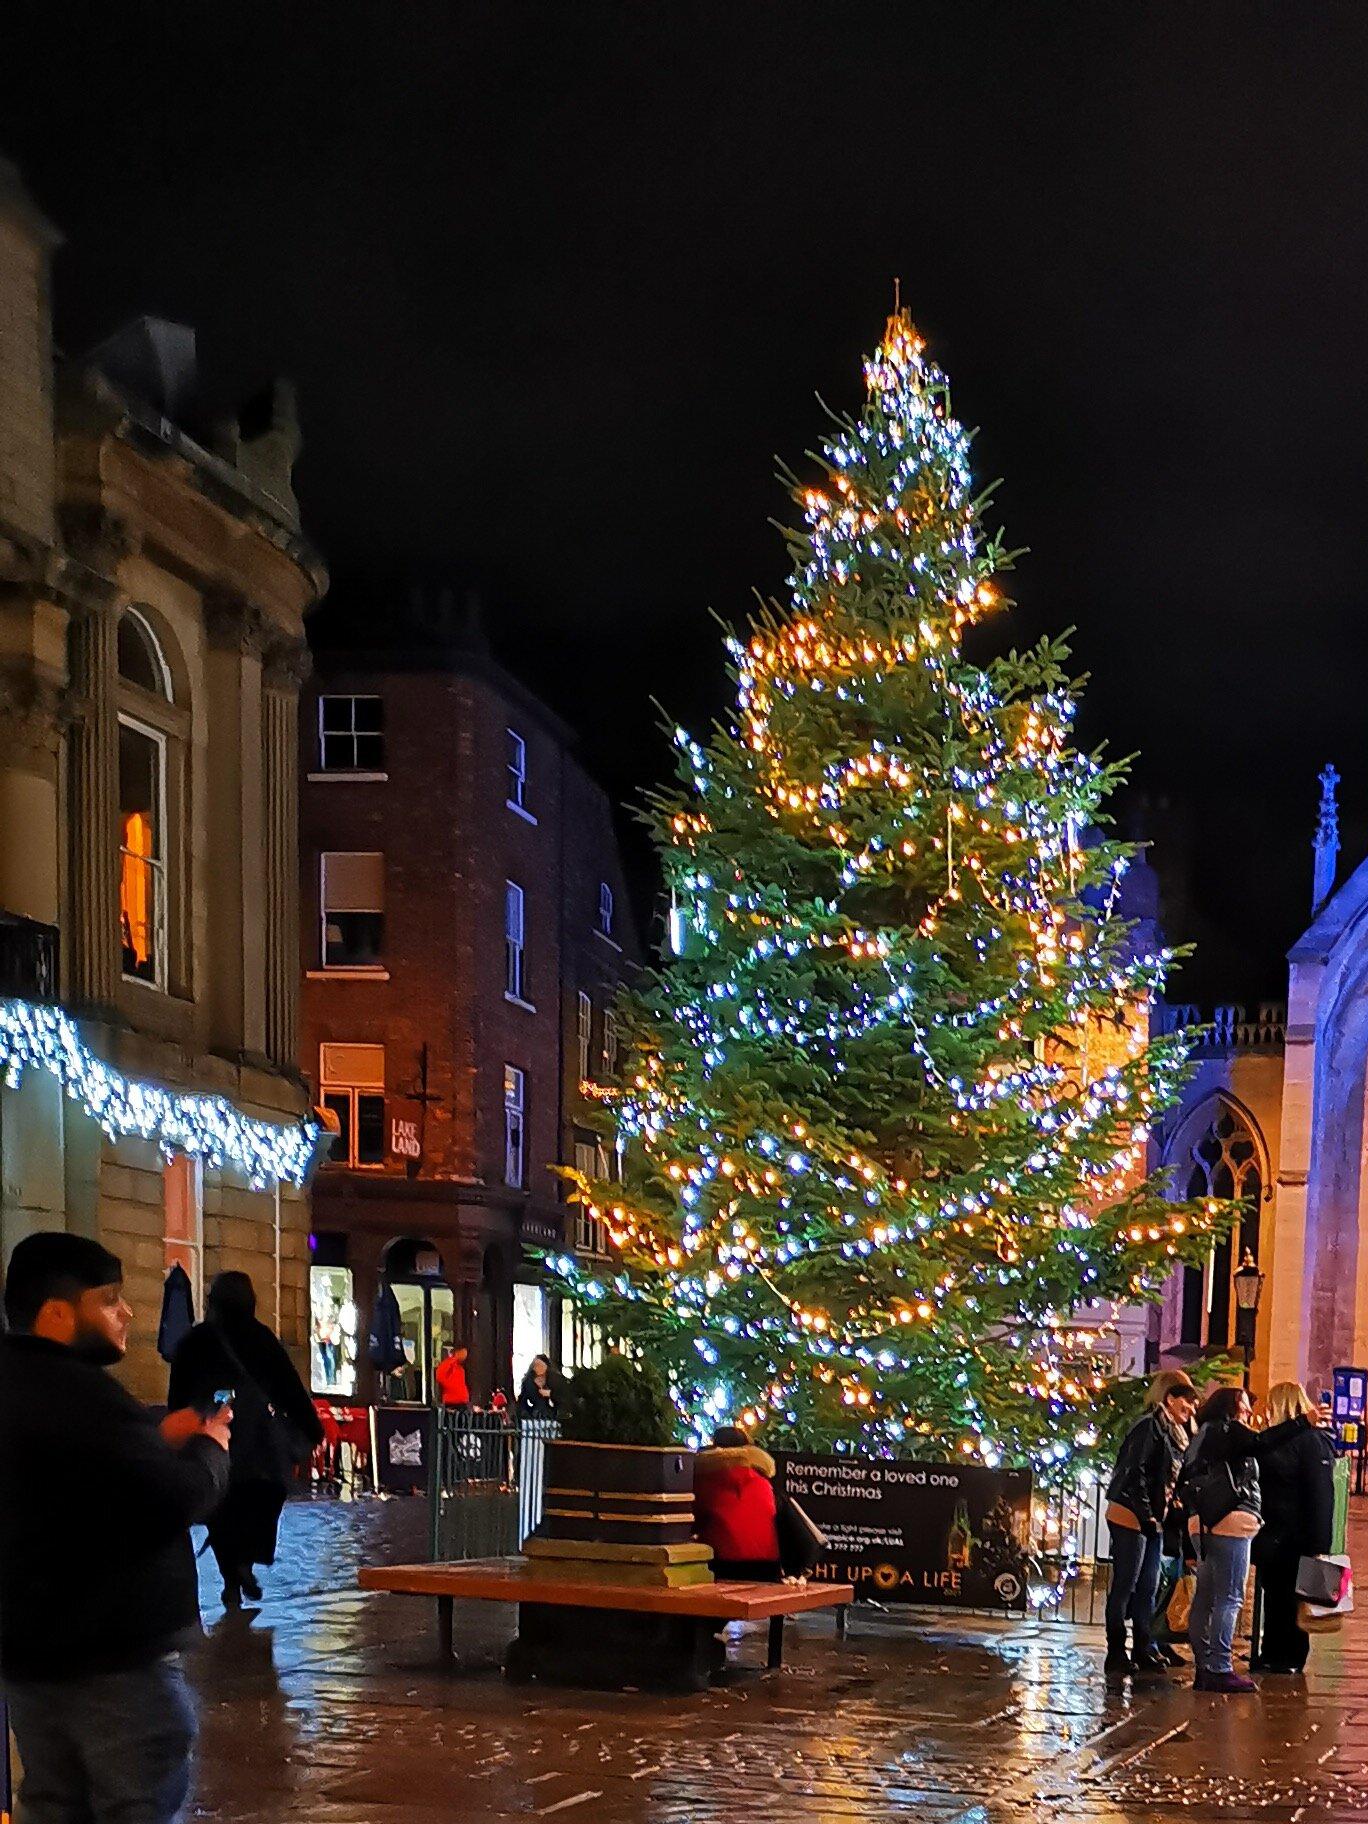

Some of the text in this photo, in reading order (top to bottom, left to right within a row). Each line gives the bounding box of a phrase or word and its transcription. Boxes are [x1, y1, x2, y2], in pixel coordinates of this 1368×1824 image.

[392, 1118, 417, 1137] LAKE
[392, 1135, 421, 1157] LAND
[786, 1460, 959, 1488] Remember a loved one
[786, 1479, 883, 1500] this Christmas
[847, 1565, 873, 1582] UP
[900, 1570, 915, 1586] A
[923, 1570, 962, 1589] LIFE
